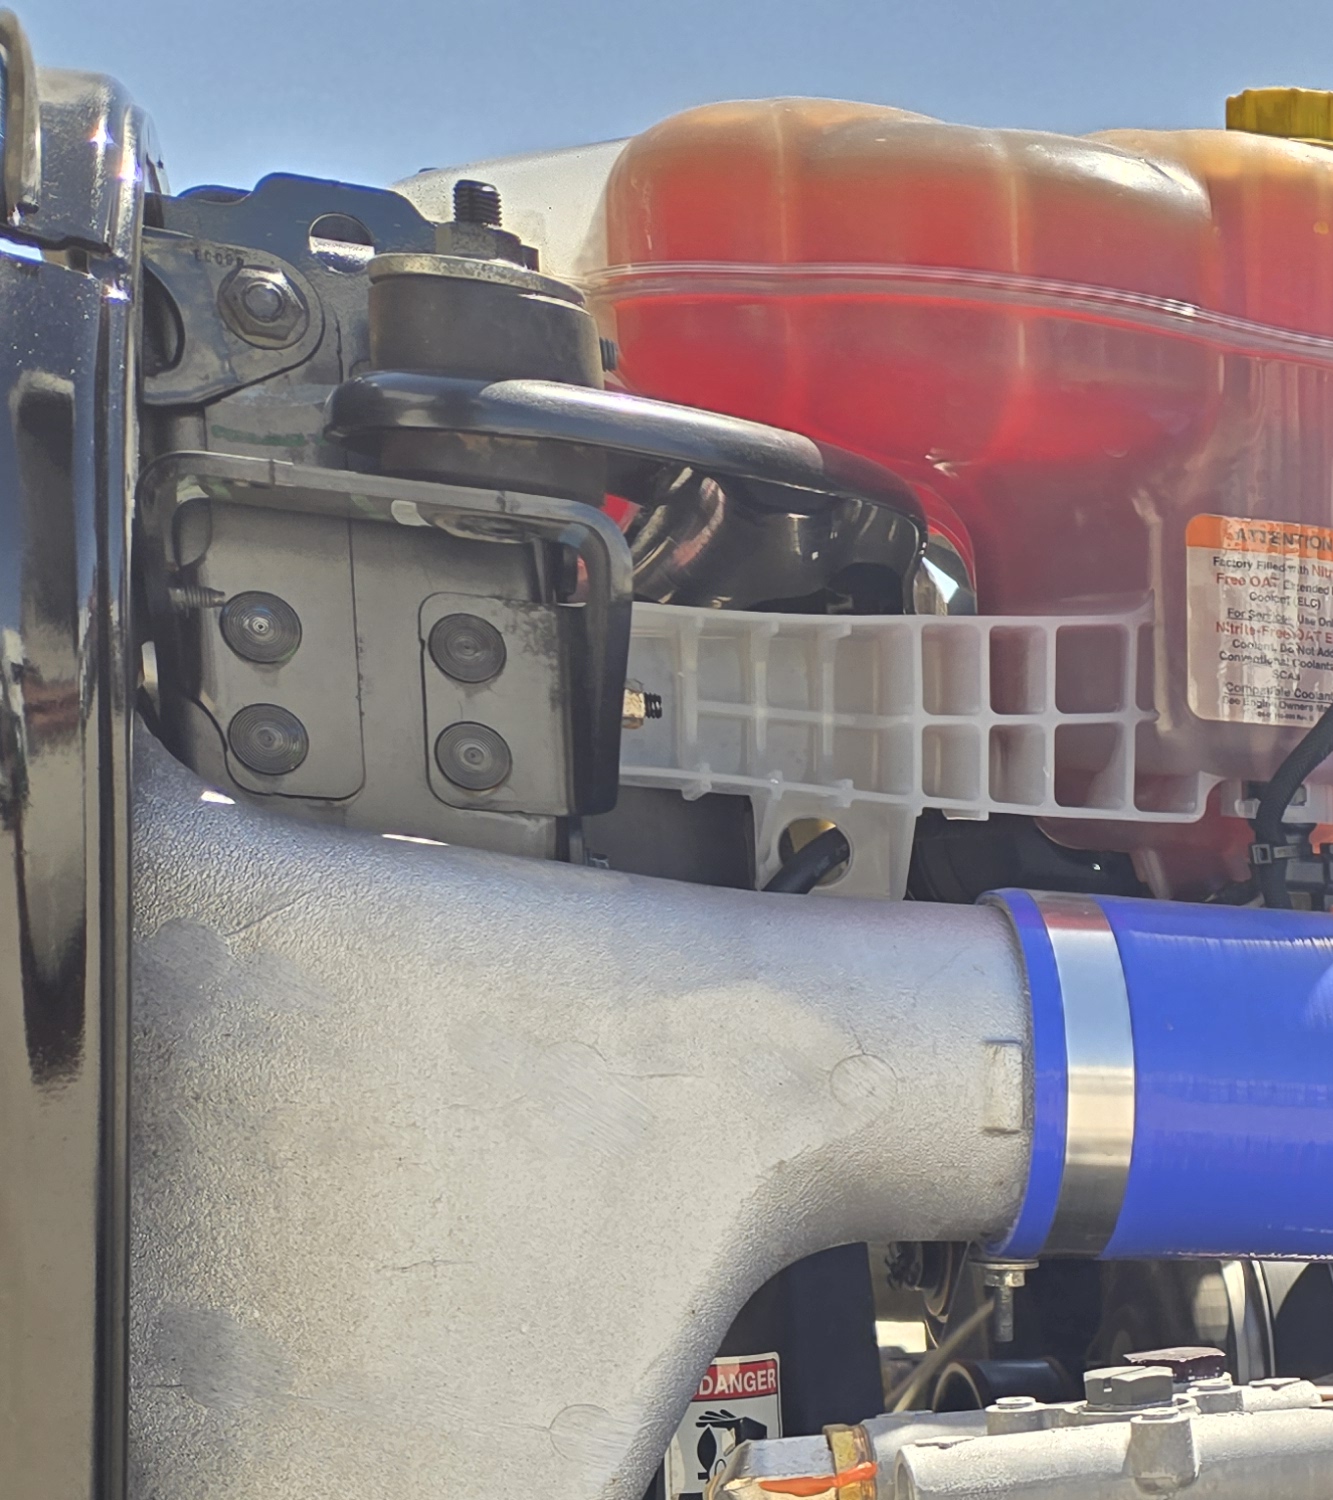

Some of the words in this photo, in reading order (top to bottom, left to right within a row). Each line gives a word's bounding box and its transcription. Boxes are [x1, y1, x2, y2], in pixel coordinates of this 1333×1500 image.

[1235, 527, 1333, 552] ATTENTION
[1212, 556, 1253, 570] Factory
[1256, 560, 1286, 573] Filled
[1216, 573, 1246, 587] Free
[1227, 608, 1246, 620] For
[1296, 646, 1316, 657] Not
[700, 1369, 777, 1396] DANGER
